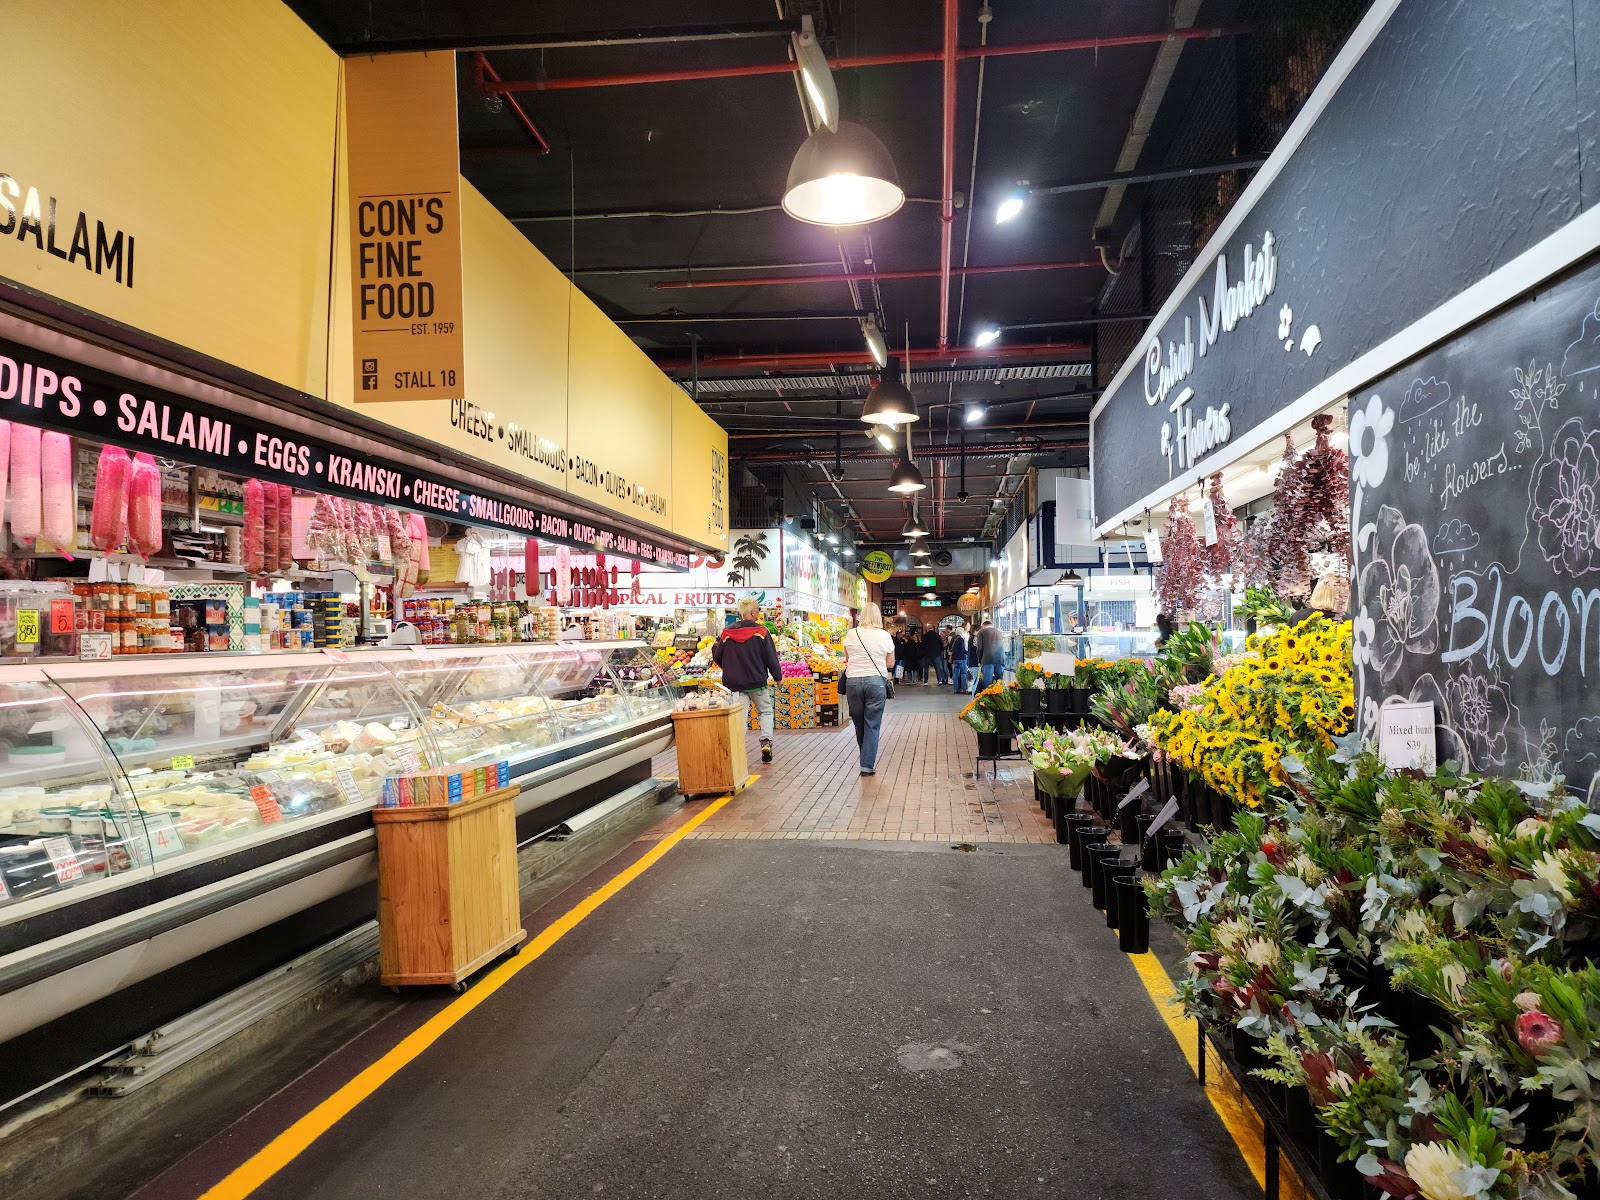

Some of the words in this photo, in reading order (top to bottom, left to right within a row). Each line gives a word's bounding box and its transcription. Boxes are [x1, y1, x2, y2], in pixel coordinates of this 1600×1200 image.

[0, 172, 135, 289] SALAMI
[358, 197, 444, 238] CON'S
[359, 240, 423, 279] FINE
[360, 281, 435, 320] FOOD
[1144, 315, 1195, 406] Central
[1199, 230, 1278, 358] Market
[411, 323, 430, 335] EST.
[433, 322, 455, 335] 1959
[394, 370, 436, 389] STALL
[440, 369, 456, 387] 18
[0, 355, 82, 418] DIPS
[117, 393, 232, 457] SALAMI
[254, 432, 311, 476] EGGS
[327, 453, 402, 499] KRANSKI
[413, 478, 461, 513] CHEESE
[468, 494, 535, 531] SMALLGOODS
[541, 513, 568, 538] BACON
[573, 522, 596, 545] OLIVES
[600, 530, 614, 549] DIPS
[617, 535, 638, 555] SALAMI
[640, 542, 653, 559] EGGS
[450, 398, 496, 443] CHEESE
[507, 421, 566, 473] SMALLGOODS
[575, 455, 599, 488] BACON
[605, 470, 627, 500] OLIVES
[649, 494, 668, 517] SALAMI
[1403, 451, 1421, 483] be
[1425, 419, 1450, 463] like
[1452, 394, 1483, 437] the
[674, 592, 736, 605] FRUITS
[1109, 578, 1131, 586] FISH
[1389, 725, 1413, 735] Mixed
[1406, 740, 1421, 751] $39
